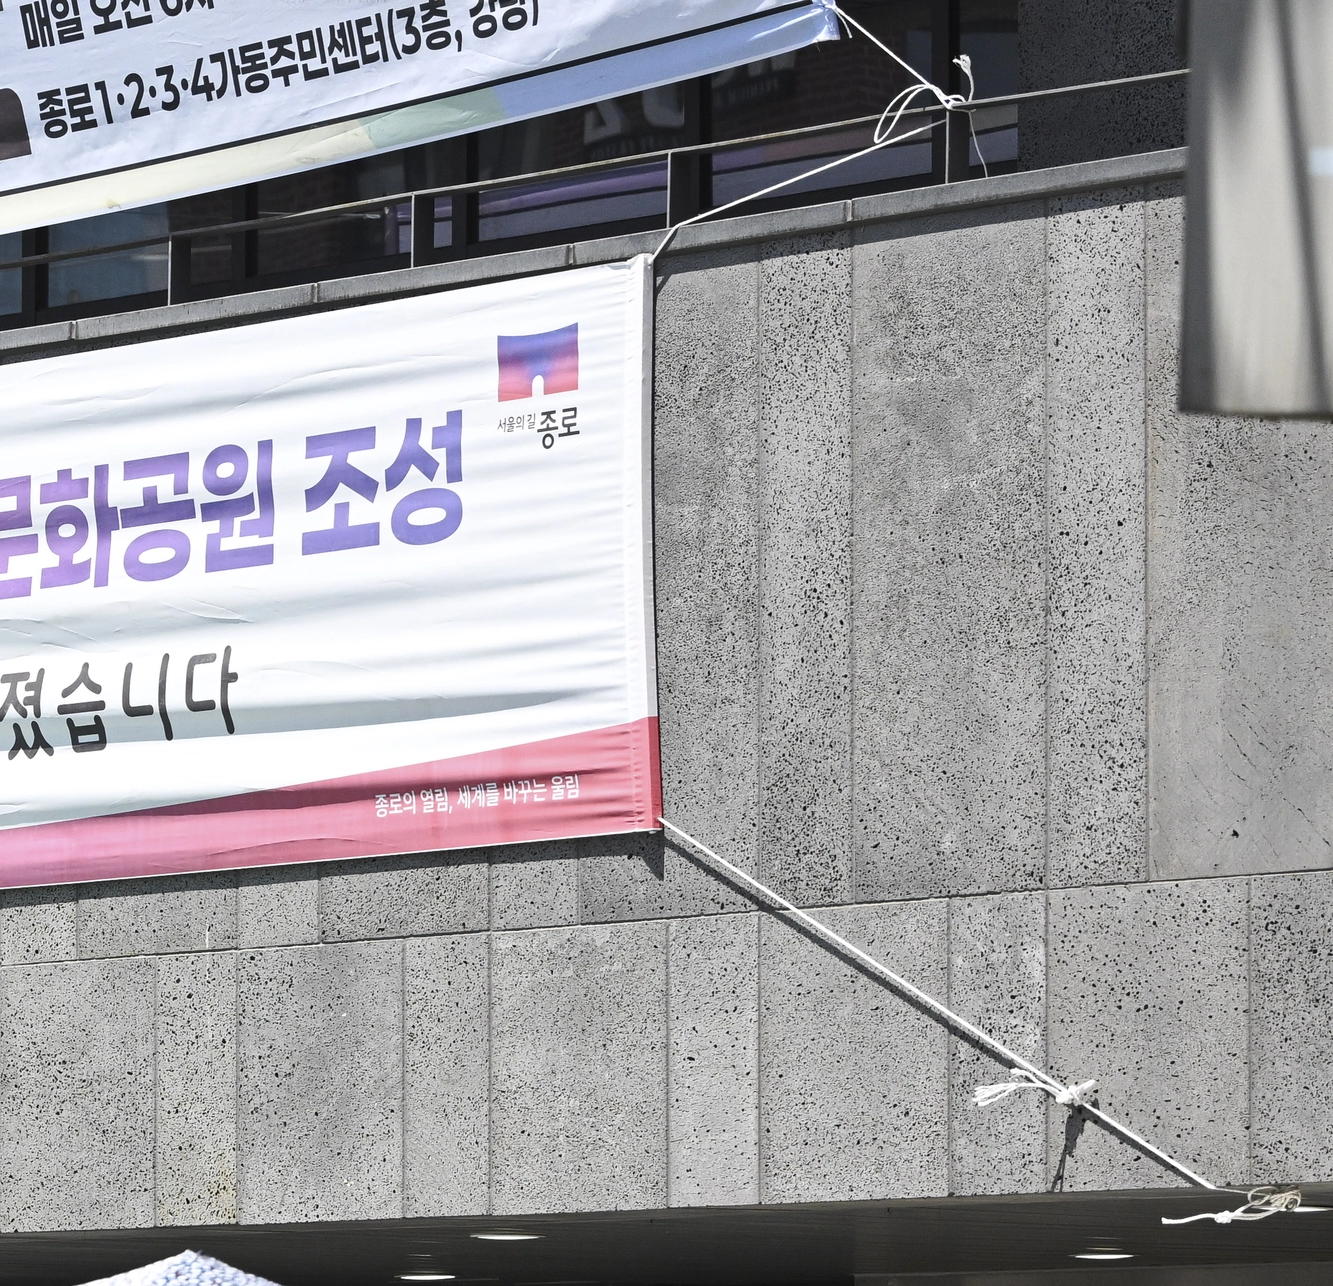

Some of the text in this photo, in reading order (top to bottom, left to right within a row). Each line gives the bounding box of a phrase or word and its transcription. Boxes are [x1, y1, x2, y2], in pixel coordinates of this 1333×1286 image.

[20, 0, 84, 49] 매일
[497, 406, 581, 450] 서울의 길 종로
[300, 409, 466, 556] 조성
[374, 773, 581, 819] 종로의 열림, 세계를 바꾸는 울림
